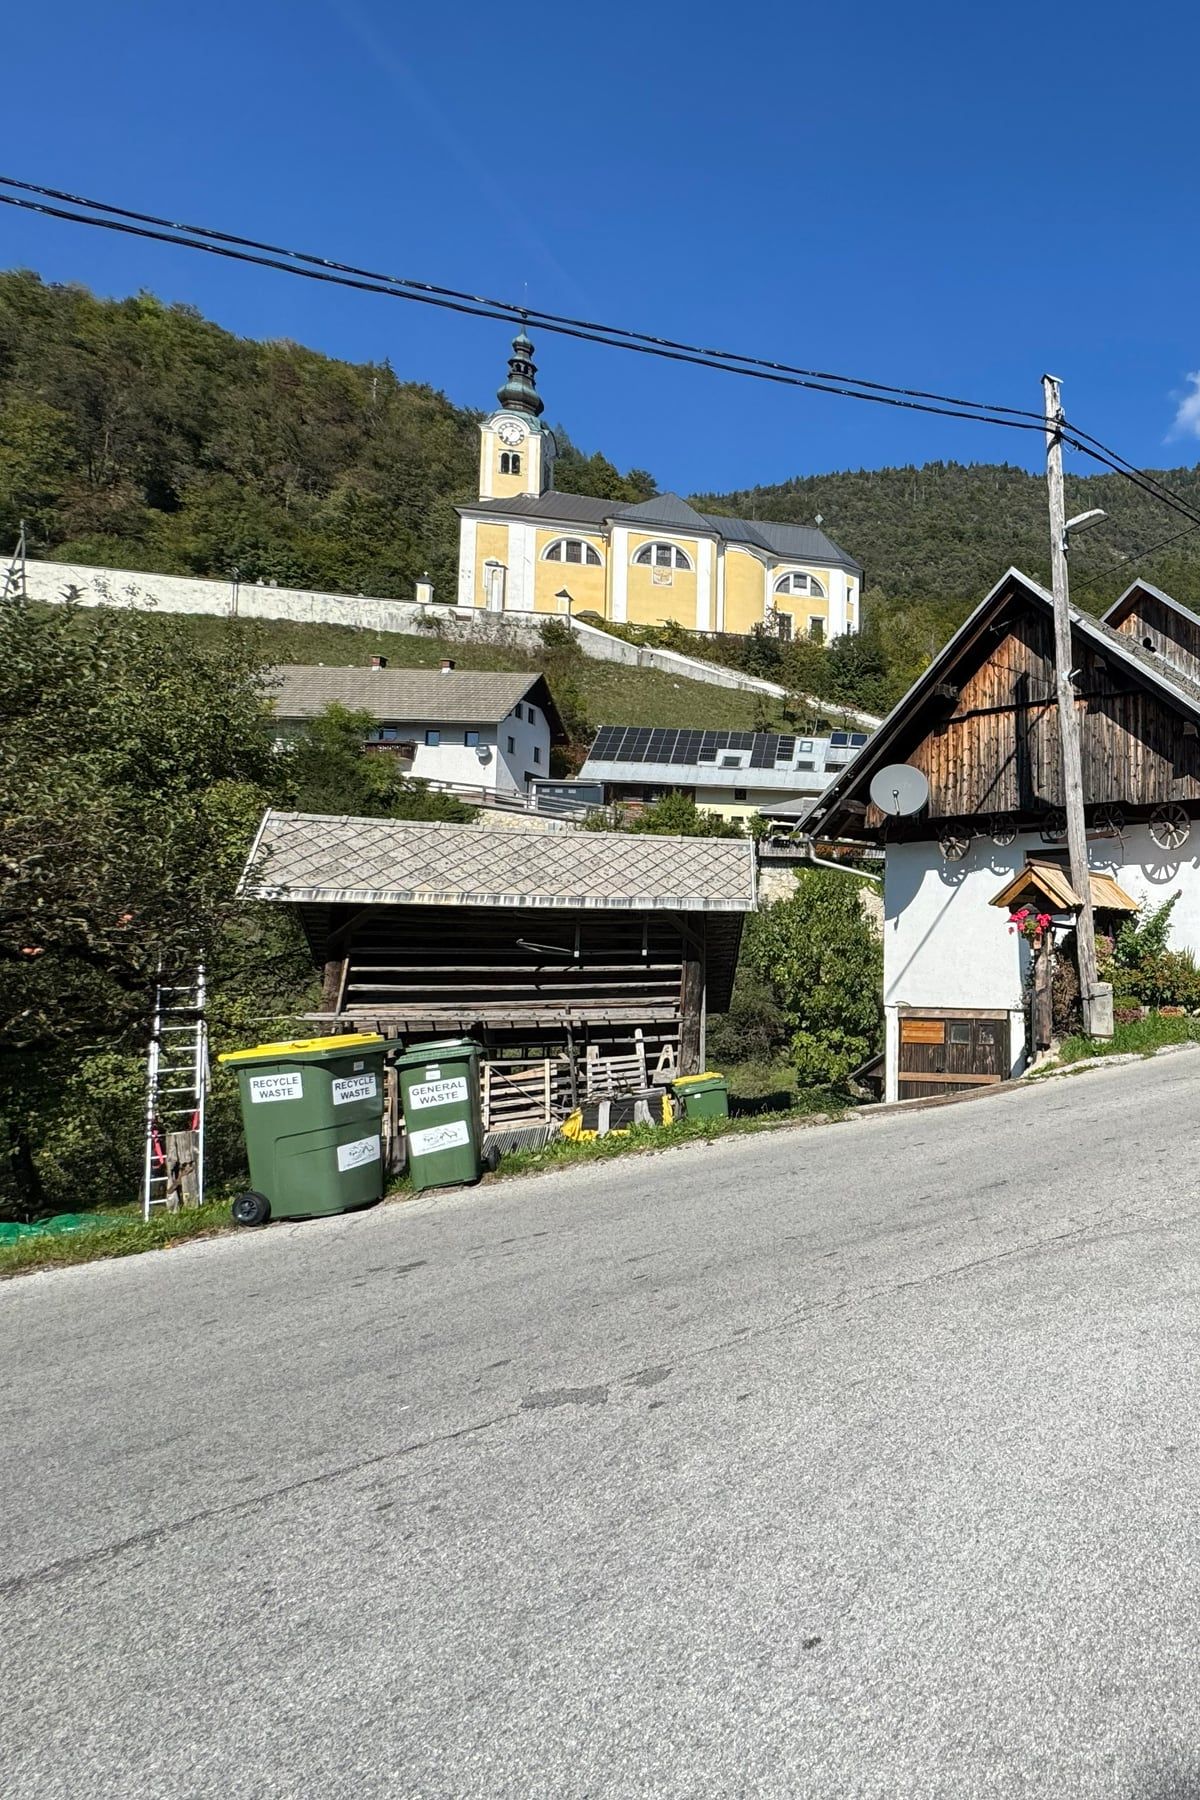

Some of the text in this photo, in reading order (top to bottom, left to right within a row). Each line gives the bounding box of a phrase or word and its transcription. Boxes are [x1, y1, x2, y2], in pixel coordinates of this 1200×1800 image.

[252, 1076, 299, 1088] RECYCLE
[335, 1076, 374, 1090] RECYCLE
[411, 1081, 464, 1096] GENERAL
[259, 1088, 294, 1098] WASTE
[340, 1087, 370, 1100] WASTE
[420, 1091, 459, 1104] WASTE
